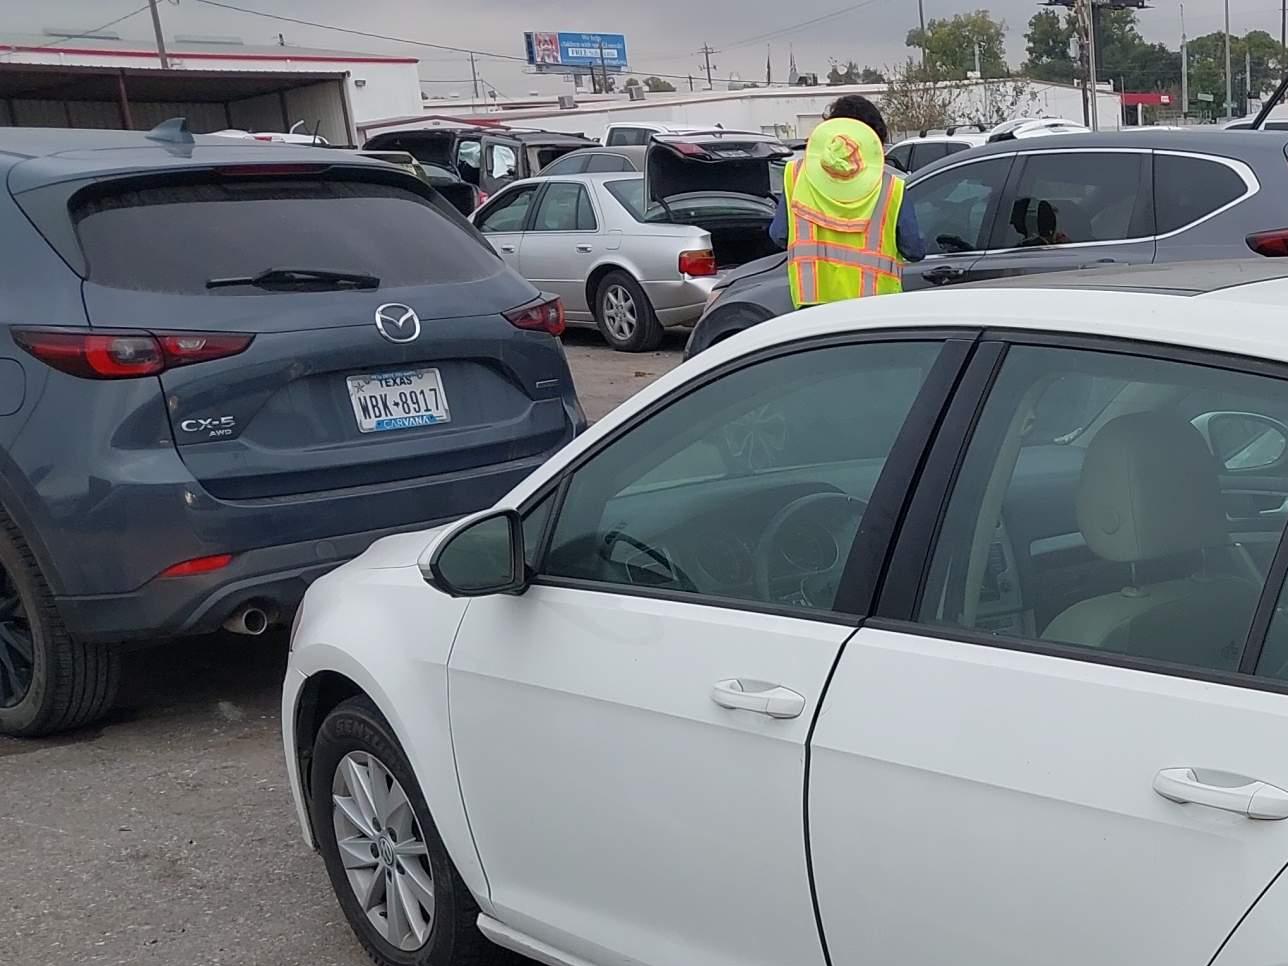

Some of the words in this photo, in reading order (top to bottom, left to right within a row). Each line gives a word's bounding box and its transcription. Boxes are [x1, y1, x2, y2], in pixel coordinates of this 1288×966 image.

[379, 376, 413, 388] TEXAS
[181, 416, 236, 432] CX-5
[383, 414, 430, 429] CARVANA
[209, 429, 232, 437] AWD
